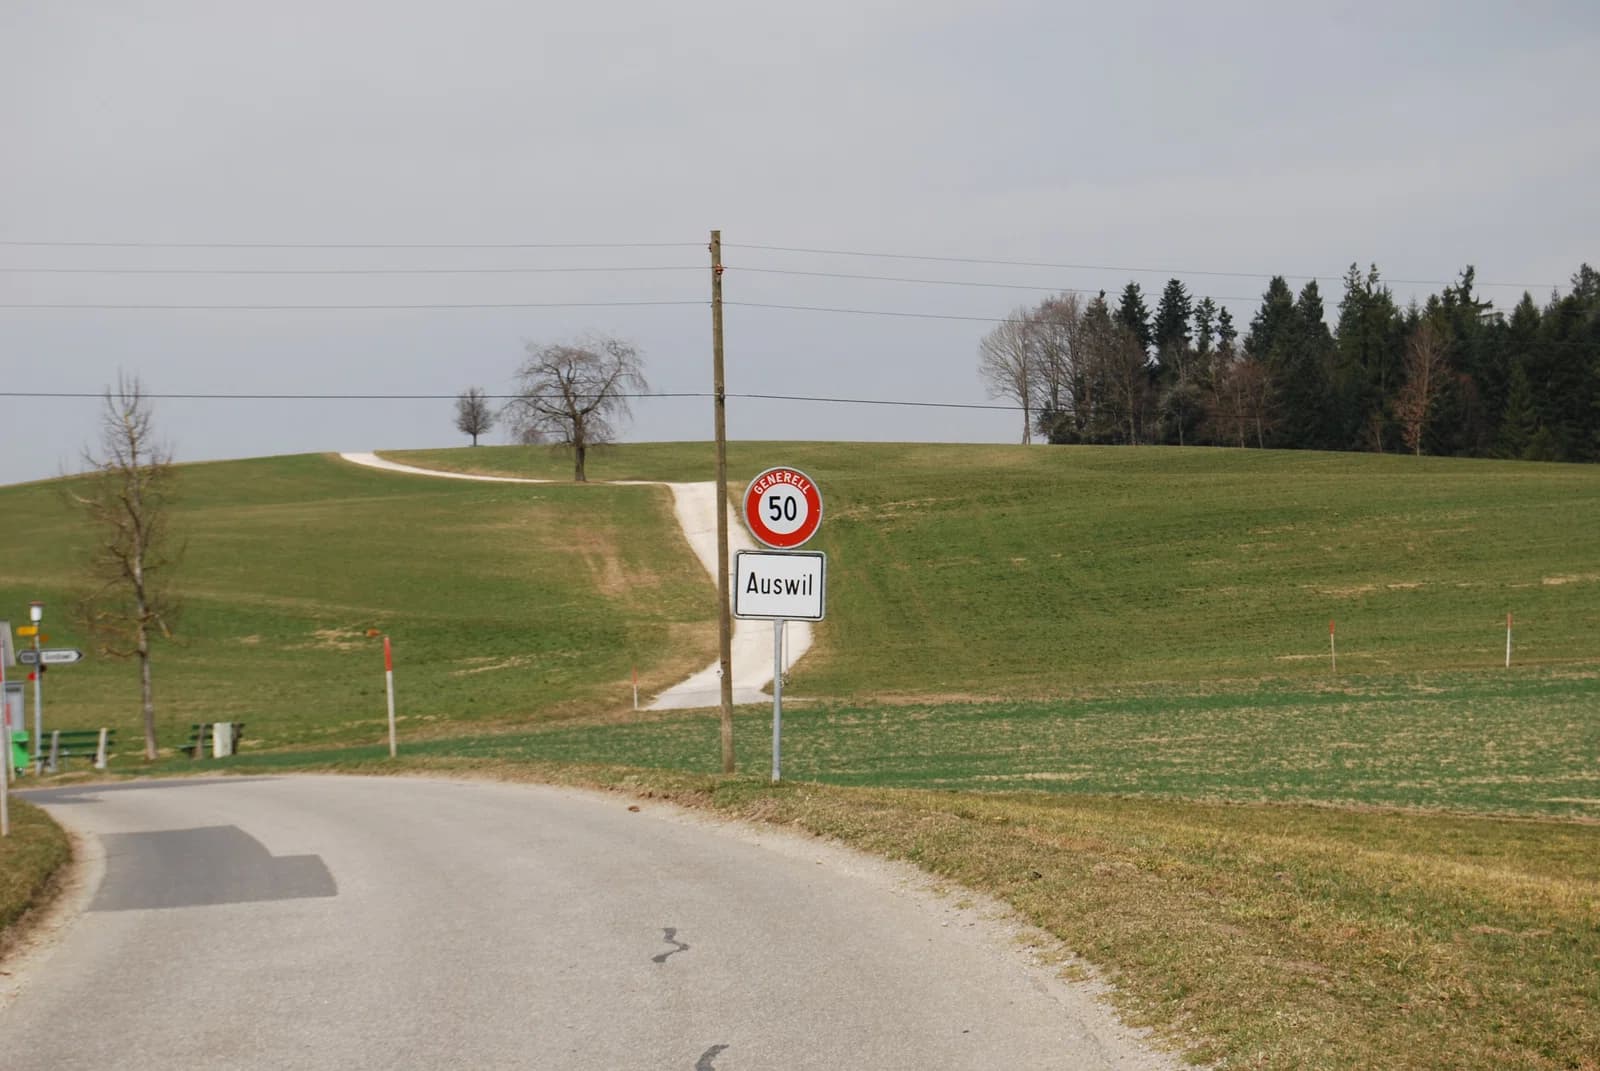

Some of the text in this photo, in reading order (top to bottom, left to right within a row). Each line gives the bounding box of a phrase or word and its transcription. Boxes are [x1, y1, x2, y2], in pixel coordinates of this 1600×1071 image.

[754, 472, 811, 494] GENERELL
[769, 496, 797, 521] 50
[746, 571, 813, 596] Auswil
